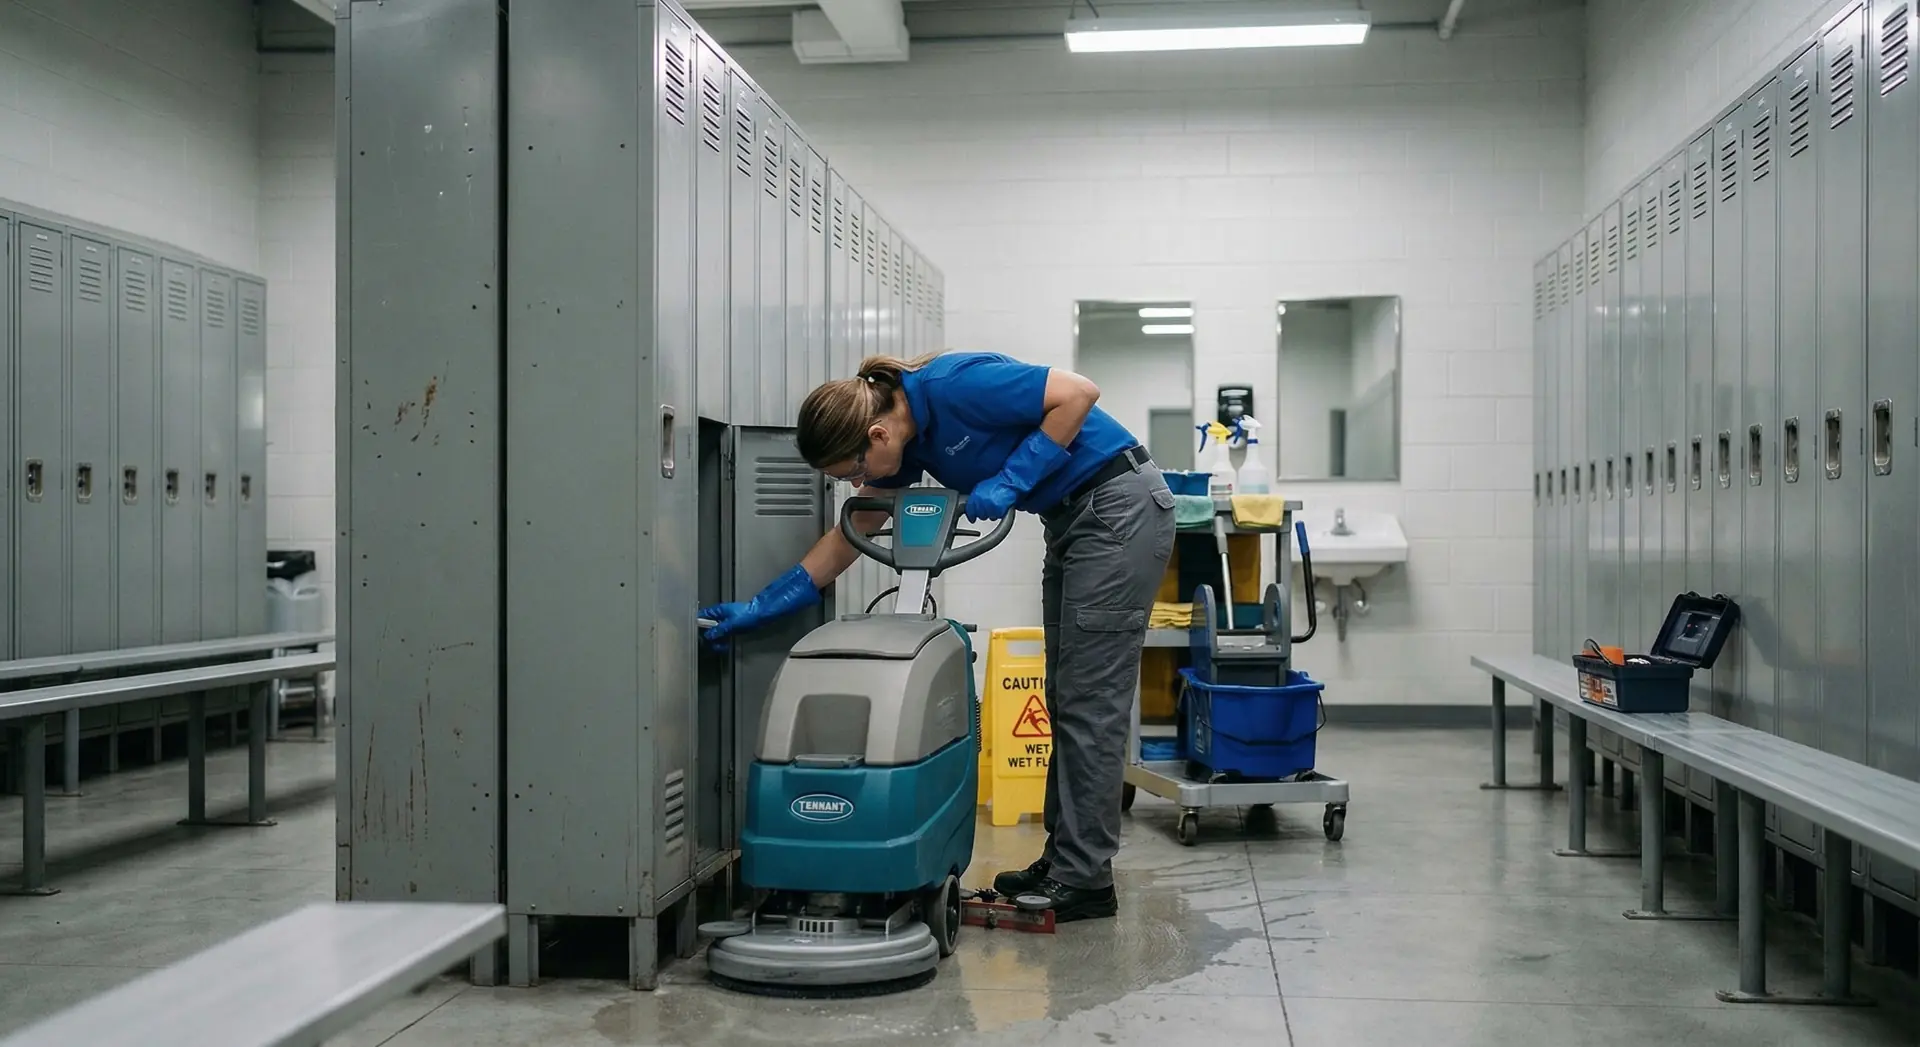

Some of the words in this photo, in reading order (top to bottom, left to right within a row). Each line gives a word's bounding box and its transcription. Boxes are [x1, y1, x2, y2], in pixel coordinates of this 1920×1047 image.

[1002, 677, 1044, 690] CAUTI
[1025, 744, 1050, 754] WET
[1008, 757, 1032, 767] WET
[799, 801, 846, 814] TENNANT
